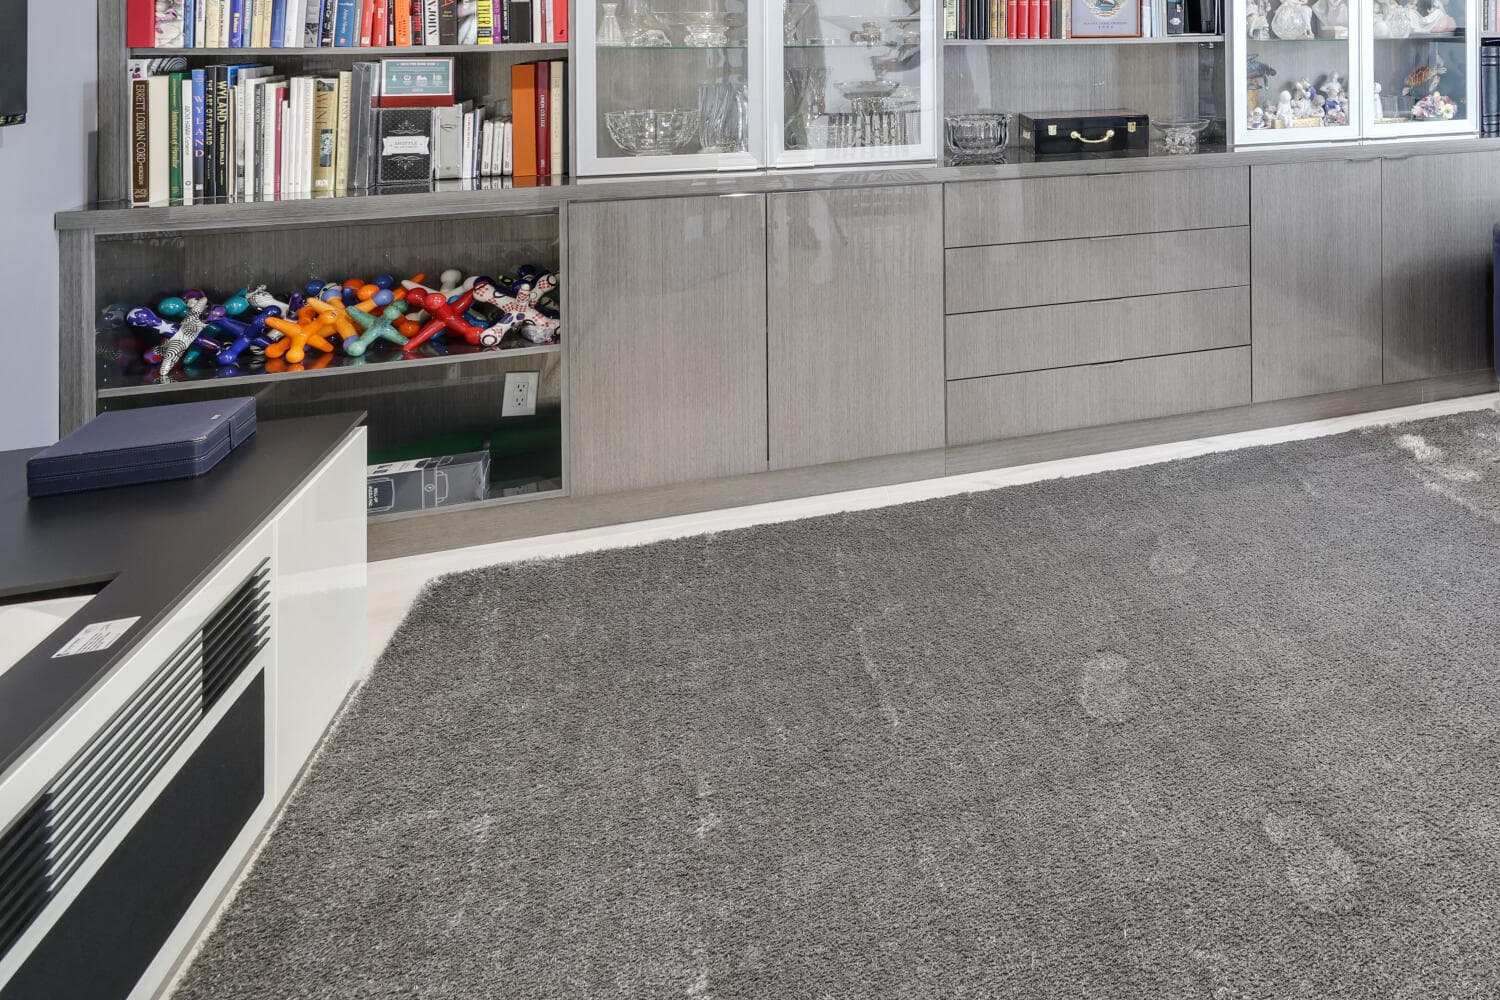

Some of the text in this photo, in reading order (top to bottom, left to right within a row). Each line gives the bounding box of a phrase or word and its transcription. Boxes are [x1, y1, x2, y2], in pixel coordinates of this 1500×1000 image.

[427, 7, 438, 35] JOHN
[477, 4, 491, 25] TYLER
[206, 108, 213, 117] OF
[216, 80, 227, 122] WYLAND
[315, 91, 329, 128] WINE
[135, 84, 146, 162] ERRETT LOBBAN CORD
[195, 94, 204, 158] WYLAND
